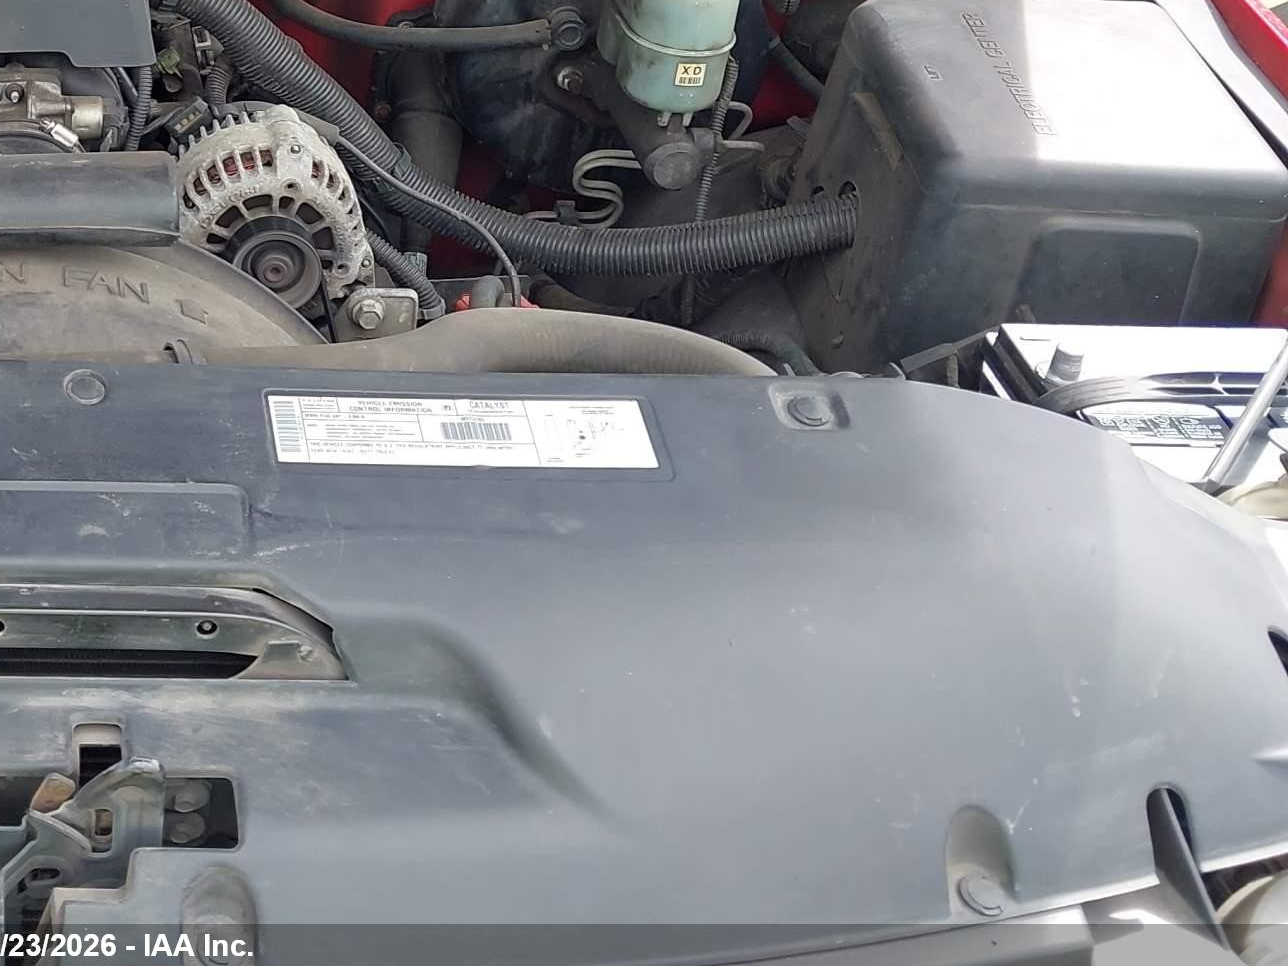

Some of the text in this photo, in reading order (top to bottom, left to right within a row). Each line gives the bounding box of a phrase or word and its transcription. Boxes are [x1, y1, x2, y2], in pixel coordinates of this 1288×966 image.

[962, 12, 1056, 135] ELECTRICAL CENTER
[62, 266, 151, 304] FAN
[469, 401, 509, 409] CATALYST
